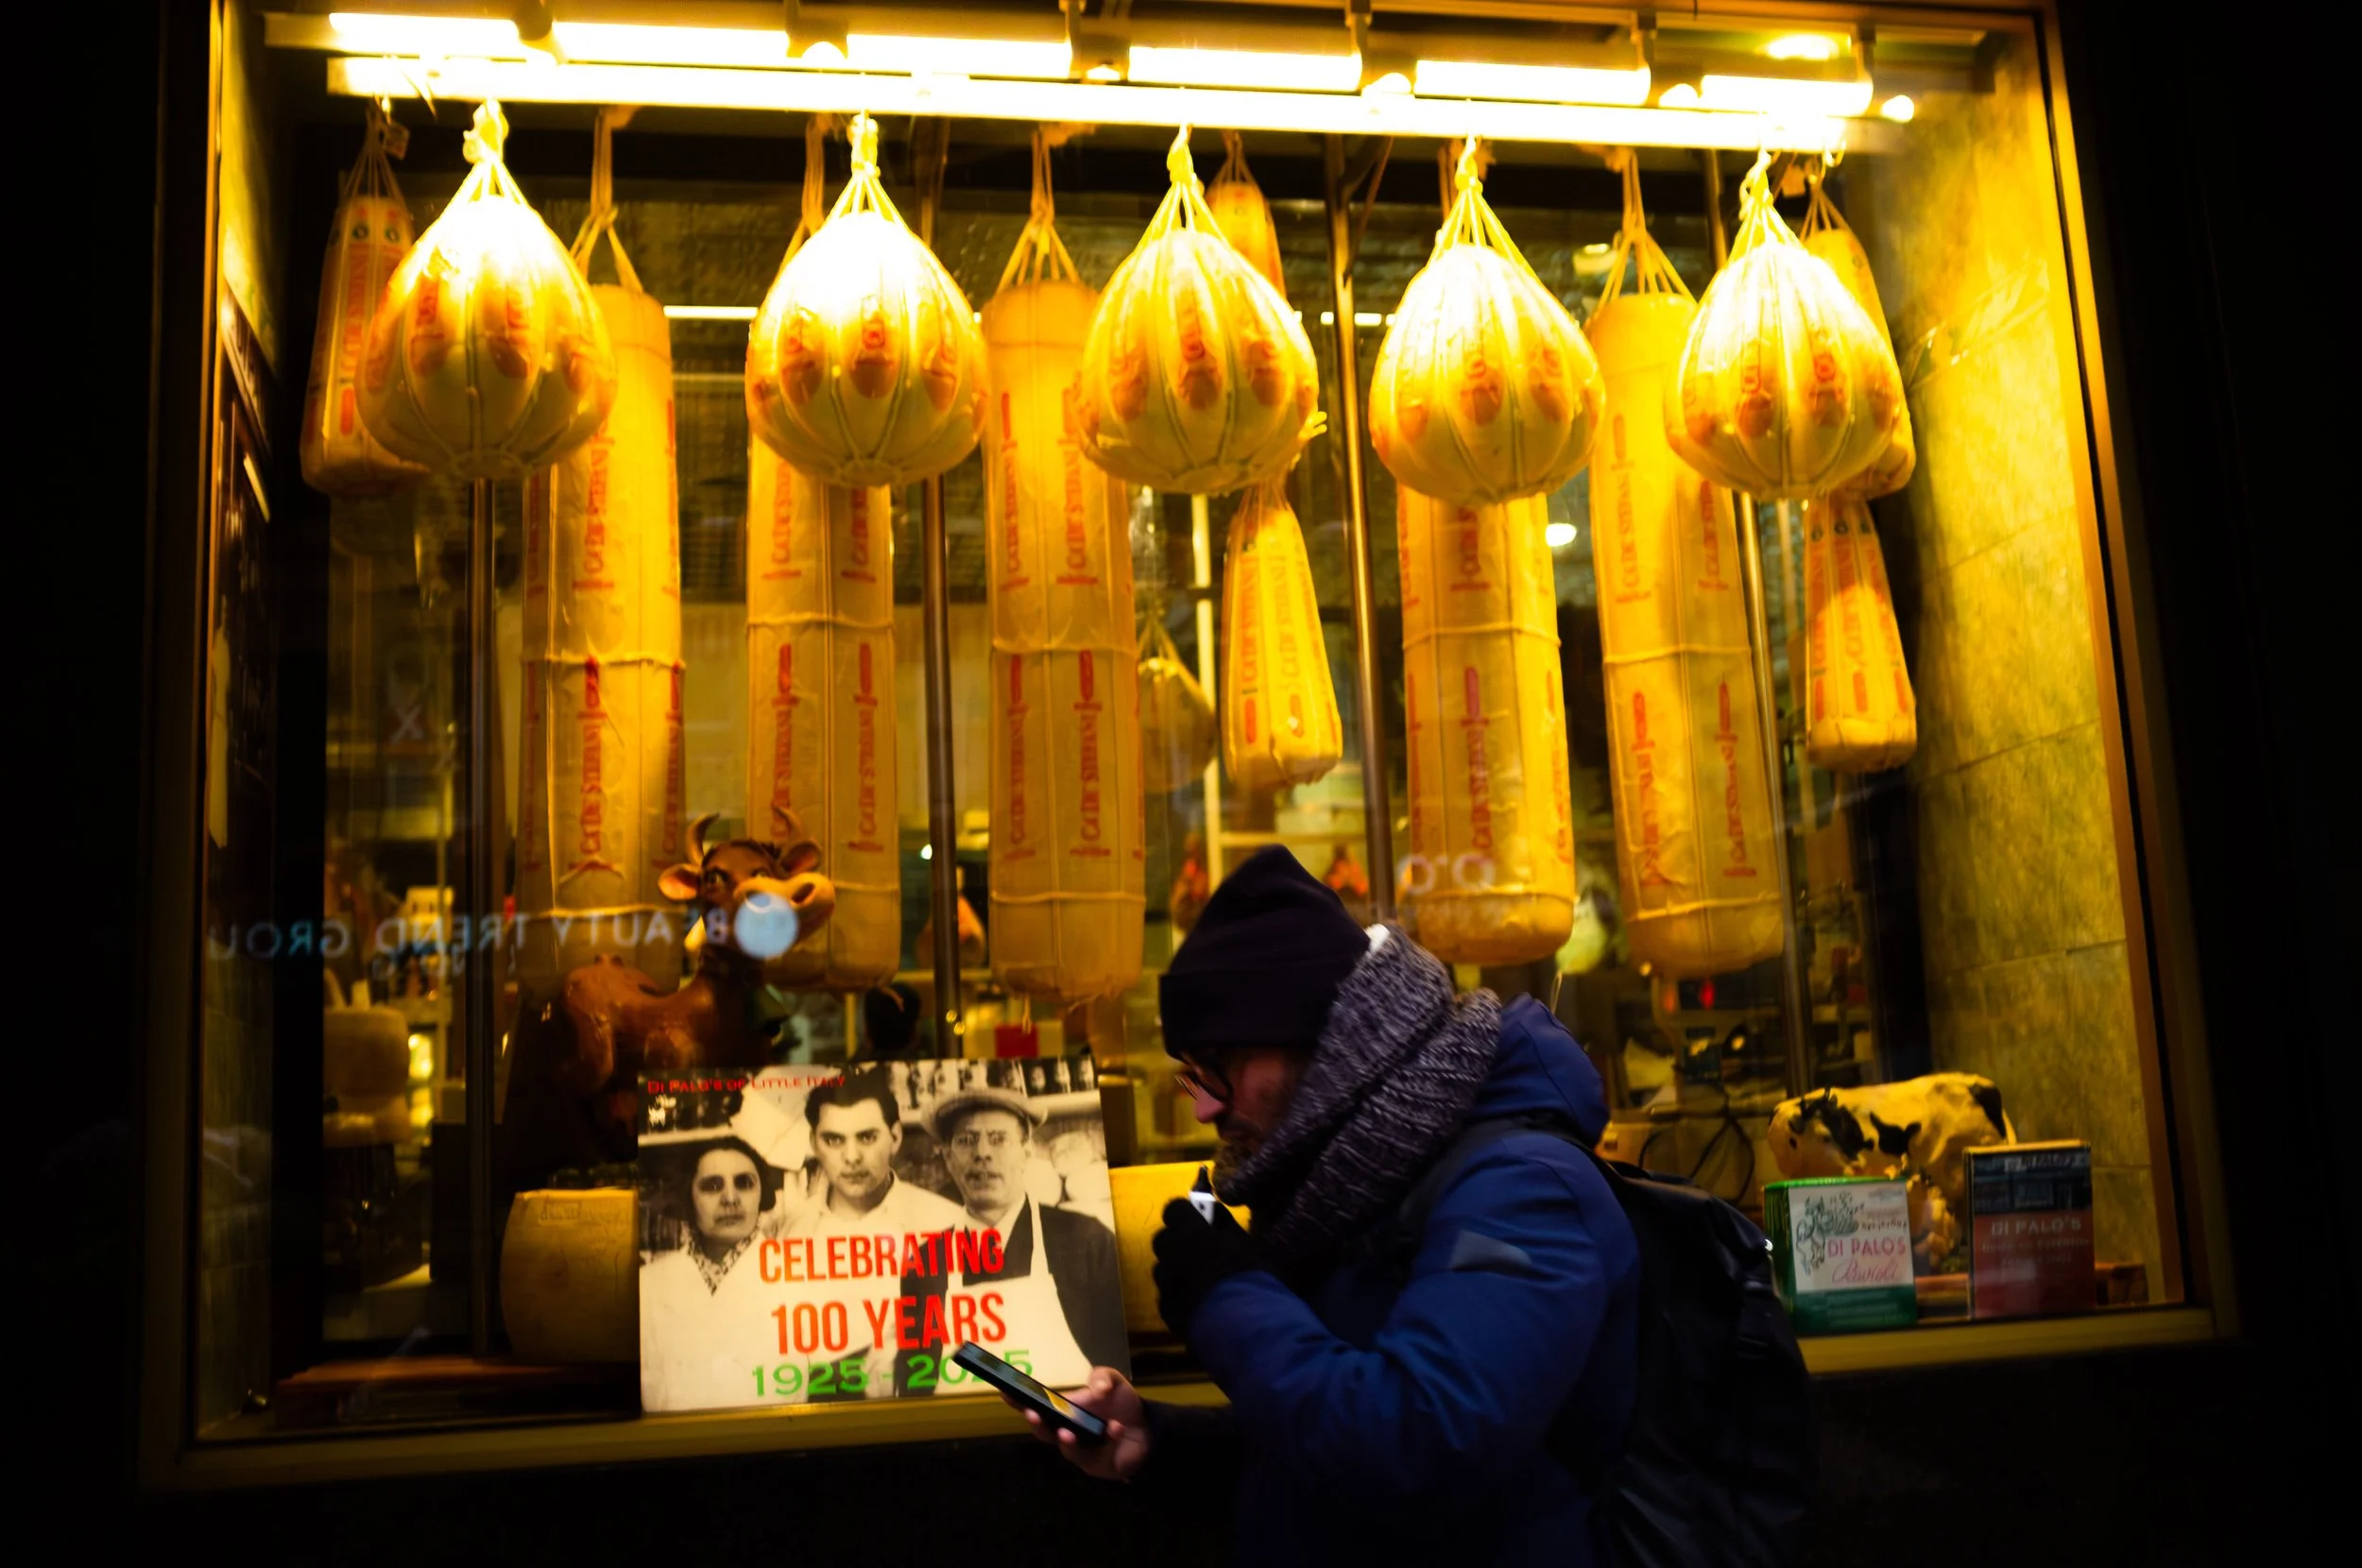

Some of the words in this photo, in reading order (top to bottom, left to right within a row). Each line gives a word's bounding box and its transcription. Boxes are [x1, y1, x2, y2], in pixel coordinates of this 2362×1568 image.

[751, 1075, 801, 1090] LITTLE
[807, 1074, 846, 1088] ITALY
[1991, 1219, 2010, 1237] DI
[2015, 1216, 2082, 1236] PALO'S
[759, 1226, 1004, 1284] CELEBRATING
[1827, 1237, 1844, 1258] DI
[1852, 1236, 1908, 1257] PALO'S
[771, 1300, 848, 1355] 100
[863, 1291, 1007, 1351] YEARS
[752, 1355, 870, 1397] 1925
[906, 1348, 1034, 1389] 205
